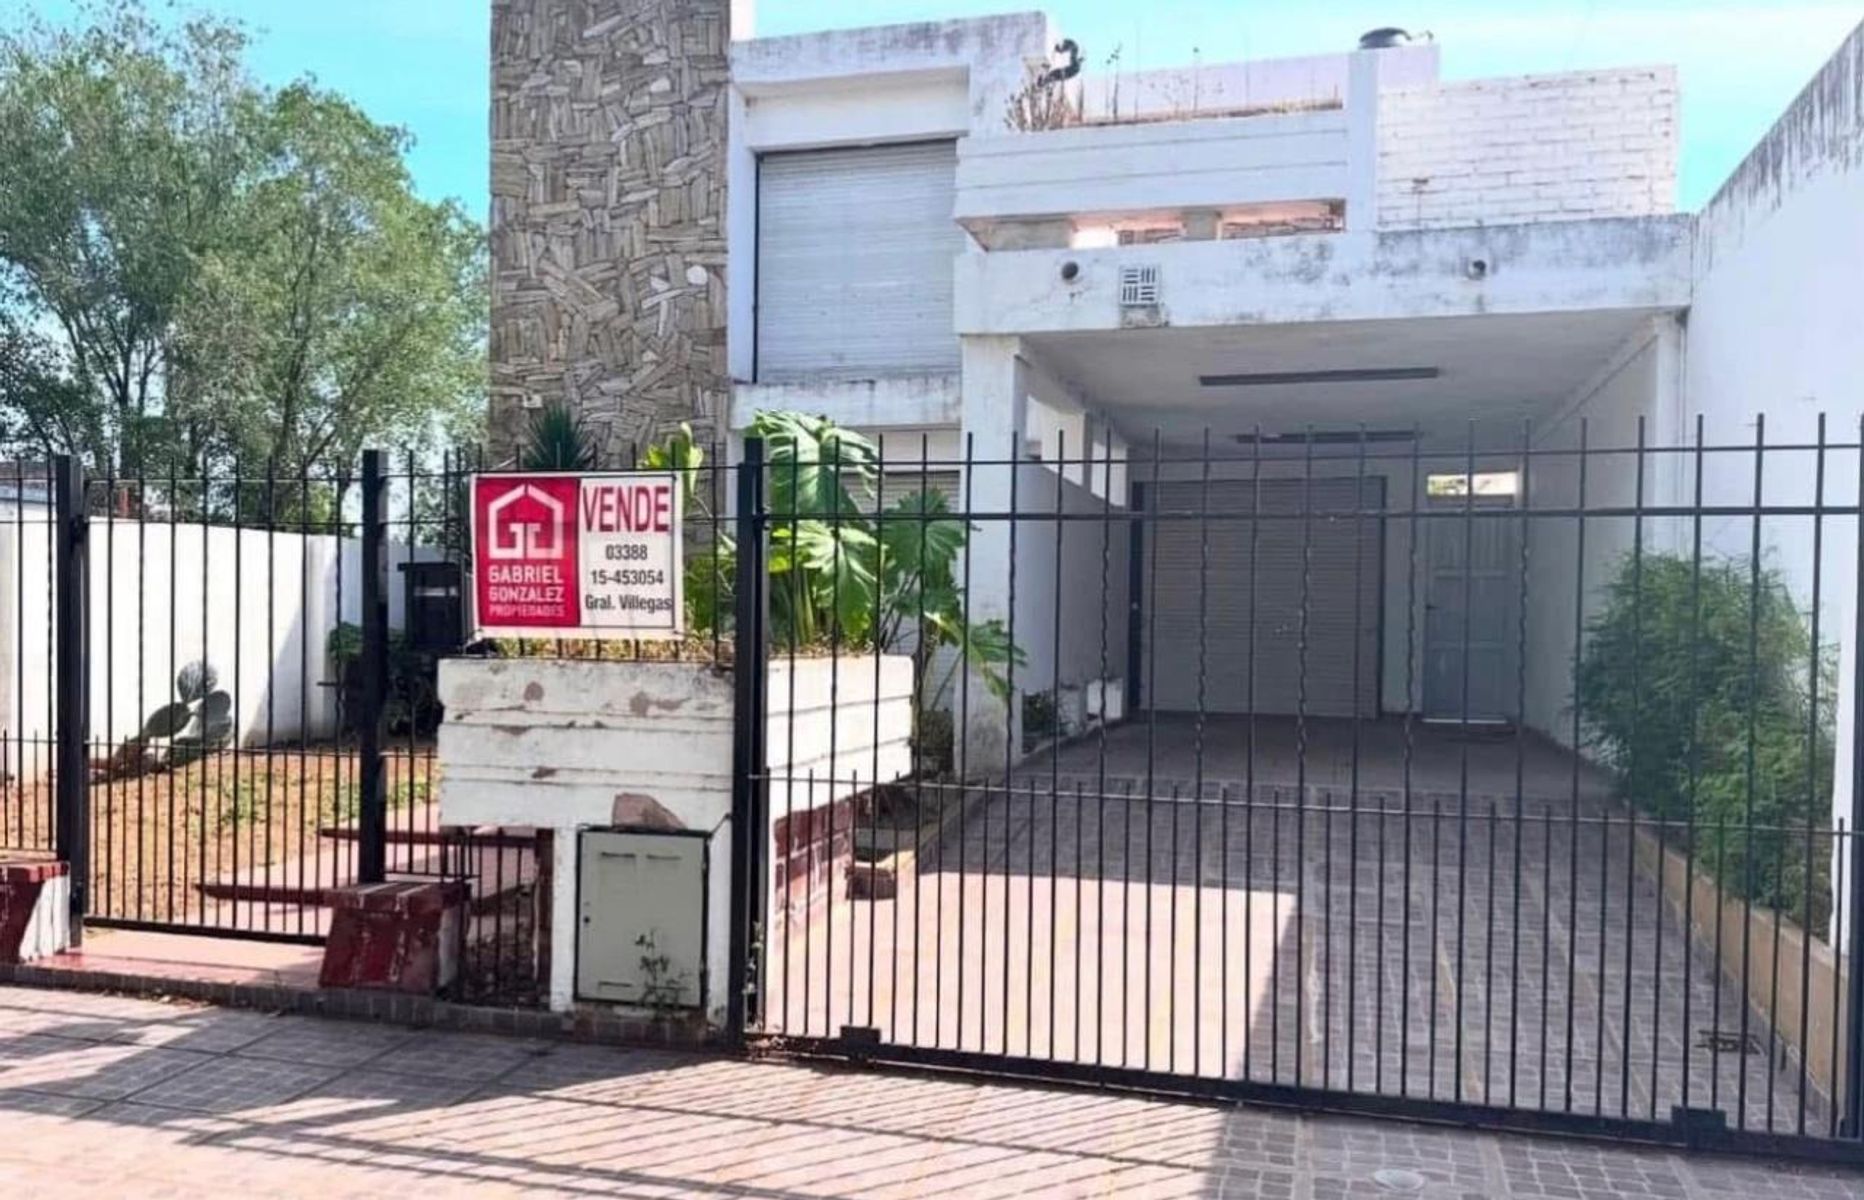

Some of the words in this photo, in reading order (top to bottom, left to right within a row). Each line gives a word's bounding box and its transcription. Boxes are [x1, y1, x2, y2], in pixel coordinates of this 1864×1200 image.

[582, 486, 670, 533] VENDE
[605, 544, 648, 560] 03388
[488, 565, 564, 584] GABRIEL
[591, 570, 664, 585] 15-453054
[488, 586, 565, 602] GONZALEZ
[489, 604, 565, 617] PROPIEDADES
[585, 594, 616, 611] Gral.
[619, 594, 673, 613] Villegas
